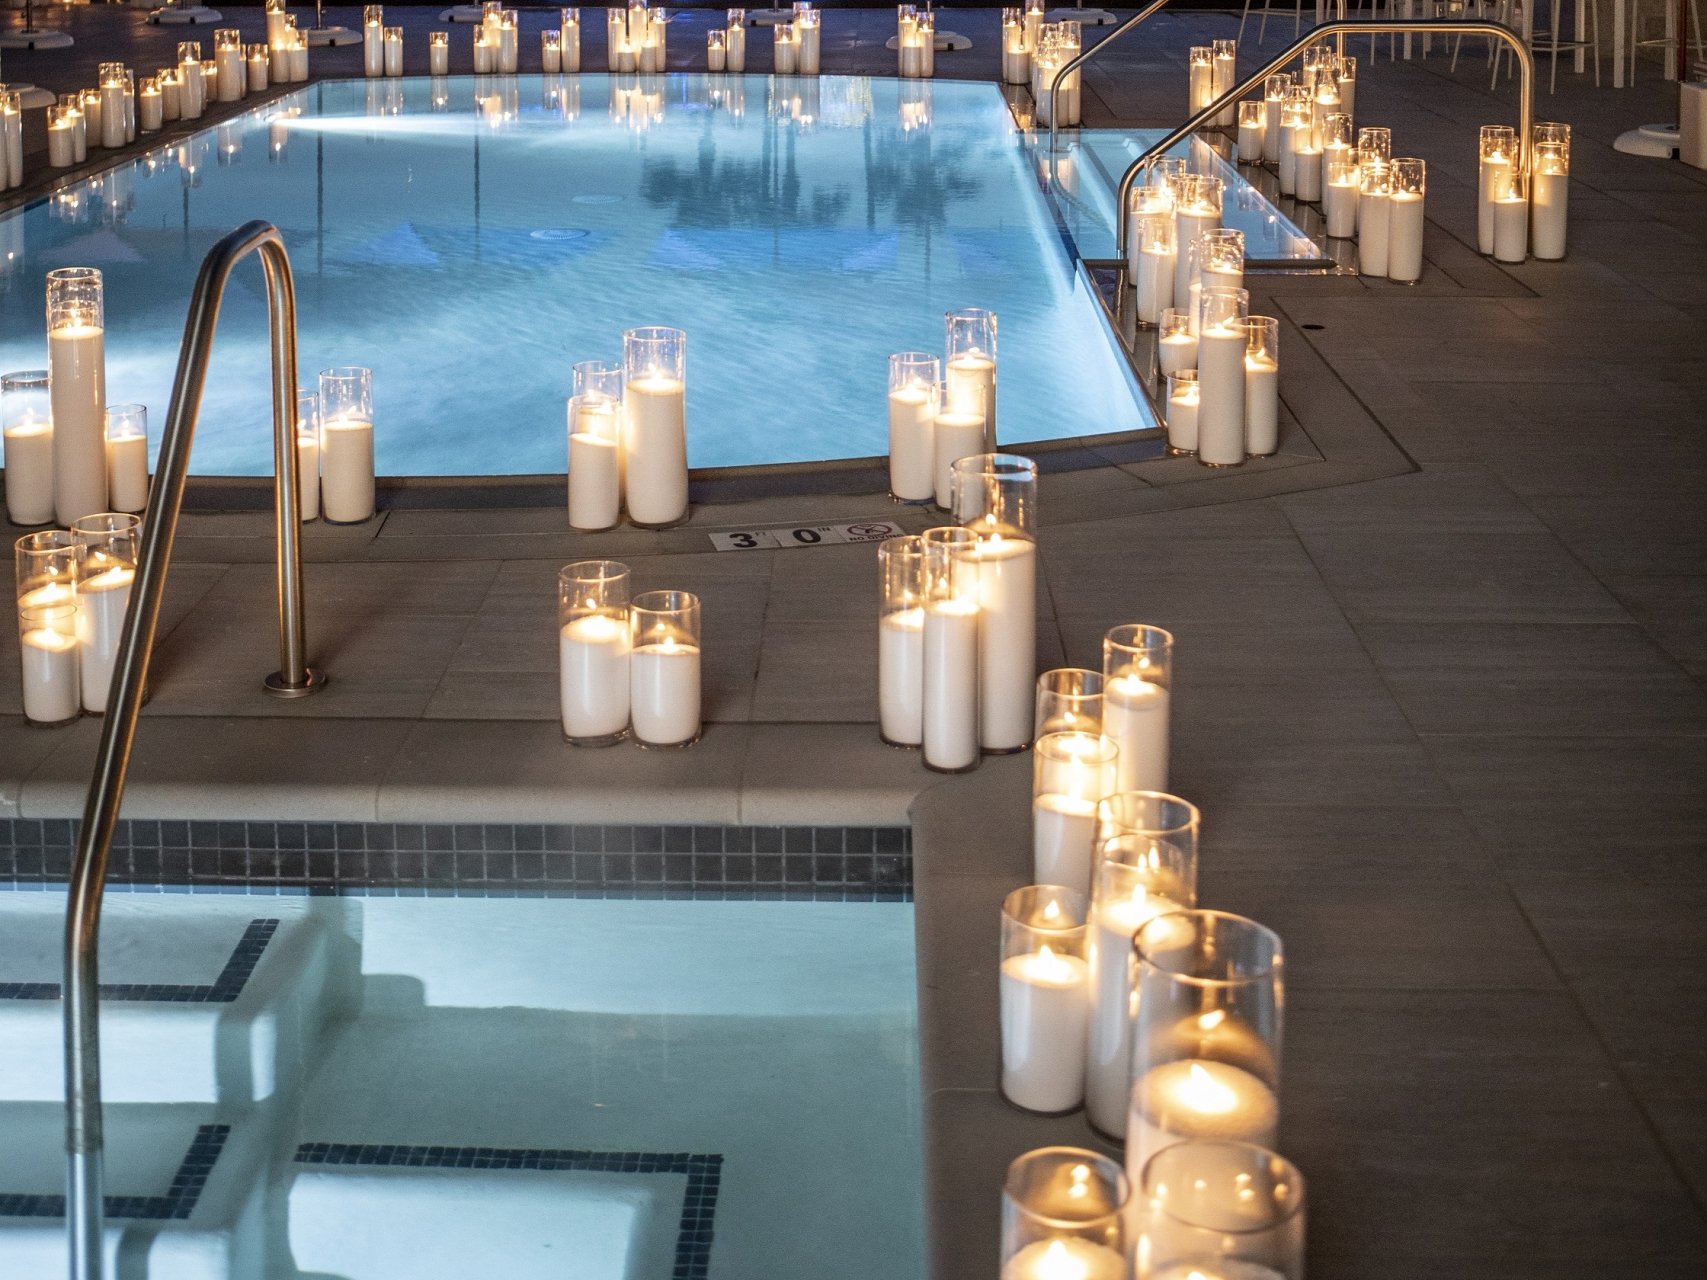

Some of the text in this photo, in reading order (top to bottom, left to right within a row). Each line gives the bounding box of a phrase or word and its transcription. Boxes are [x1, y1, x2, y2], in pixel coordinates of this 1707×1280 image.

[728, 533, 757, 548] 3
[792, 528, 821, 544] 0
[867, 533, 904, 541] DIVING
